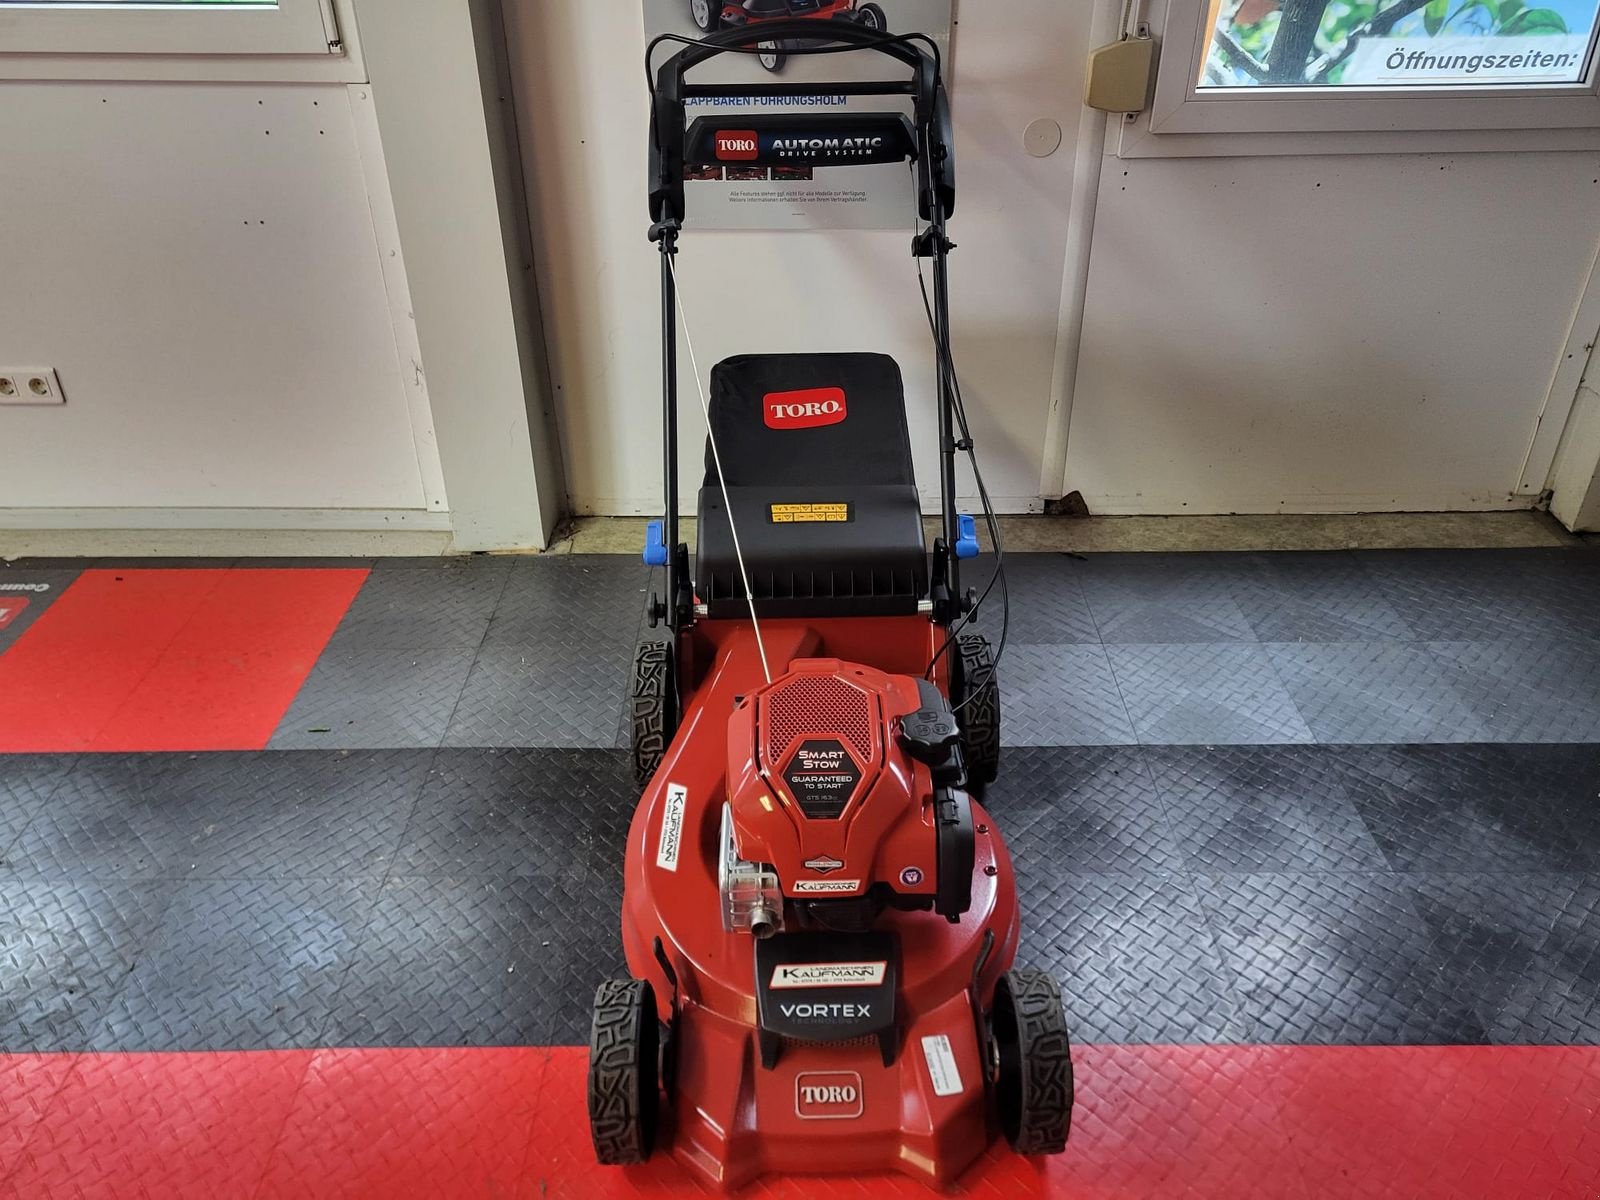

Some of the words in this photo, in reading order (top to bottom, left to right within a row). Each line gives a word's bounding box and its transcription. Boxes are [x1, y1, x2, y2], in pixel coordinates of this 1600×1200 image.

[1385, 47, 1579, 73] Öffnungszeiten:
[718, 139, 755, 151] TORO
[772, 137, 882, 149] AUTOMATIC
[770, 400, 840, 418] TORO
[798, 750, 845, 759] SMART
[803, 760, 840, 769] STOW
[791, 775, 853, 783] GUARANTEED
[664, 791, 685, 862] KAUFMANN
[796, 882, 857, 890] KAUFMANN
[782, 968, 875, 979] KAUFMANN
[780, 1004, 871, 1017] VORTEX
[801, 1085, 857, 1104] TORO
